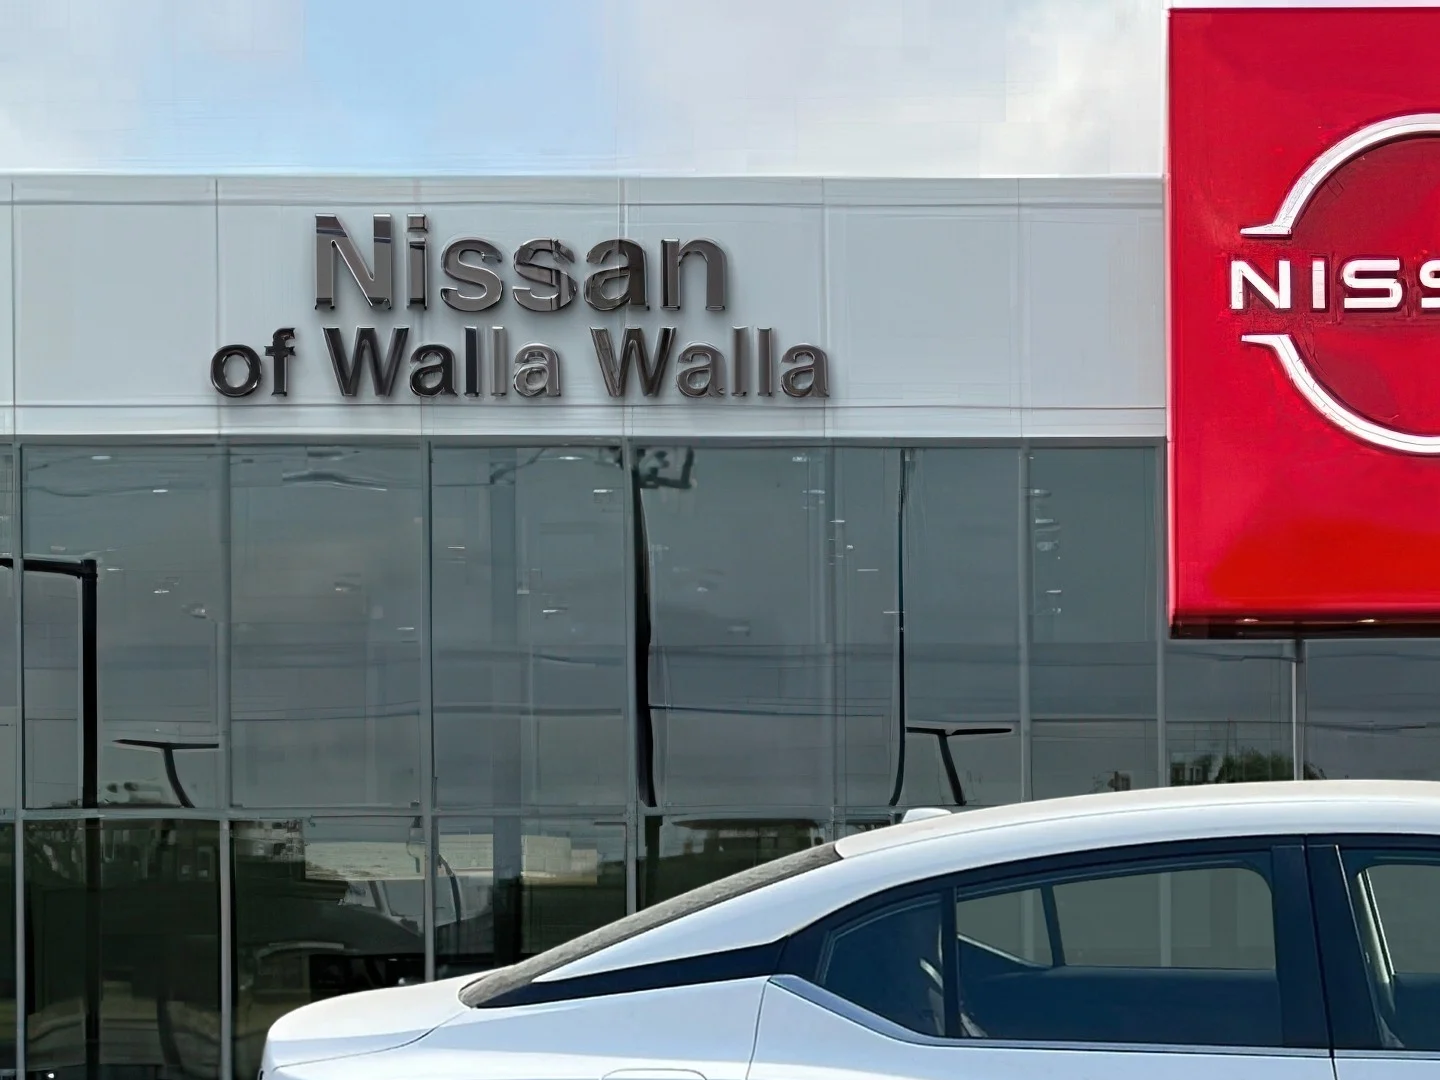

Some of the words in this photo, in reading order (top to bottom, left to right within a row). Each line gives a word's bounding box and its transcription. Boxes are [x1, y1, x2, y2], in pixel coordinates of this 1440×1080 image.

[314, 212, 728, 312] Nissan
[209, 326, 296, 398] of
[322, 326, 561, 398] Walla
[589, 326, 830, 398] Walla
